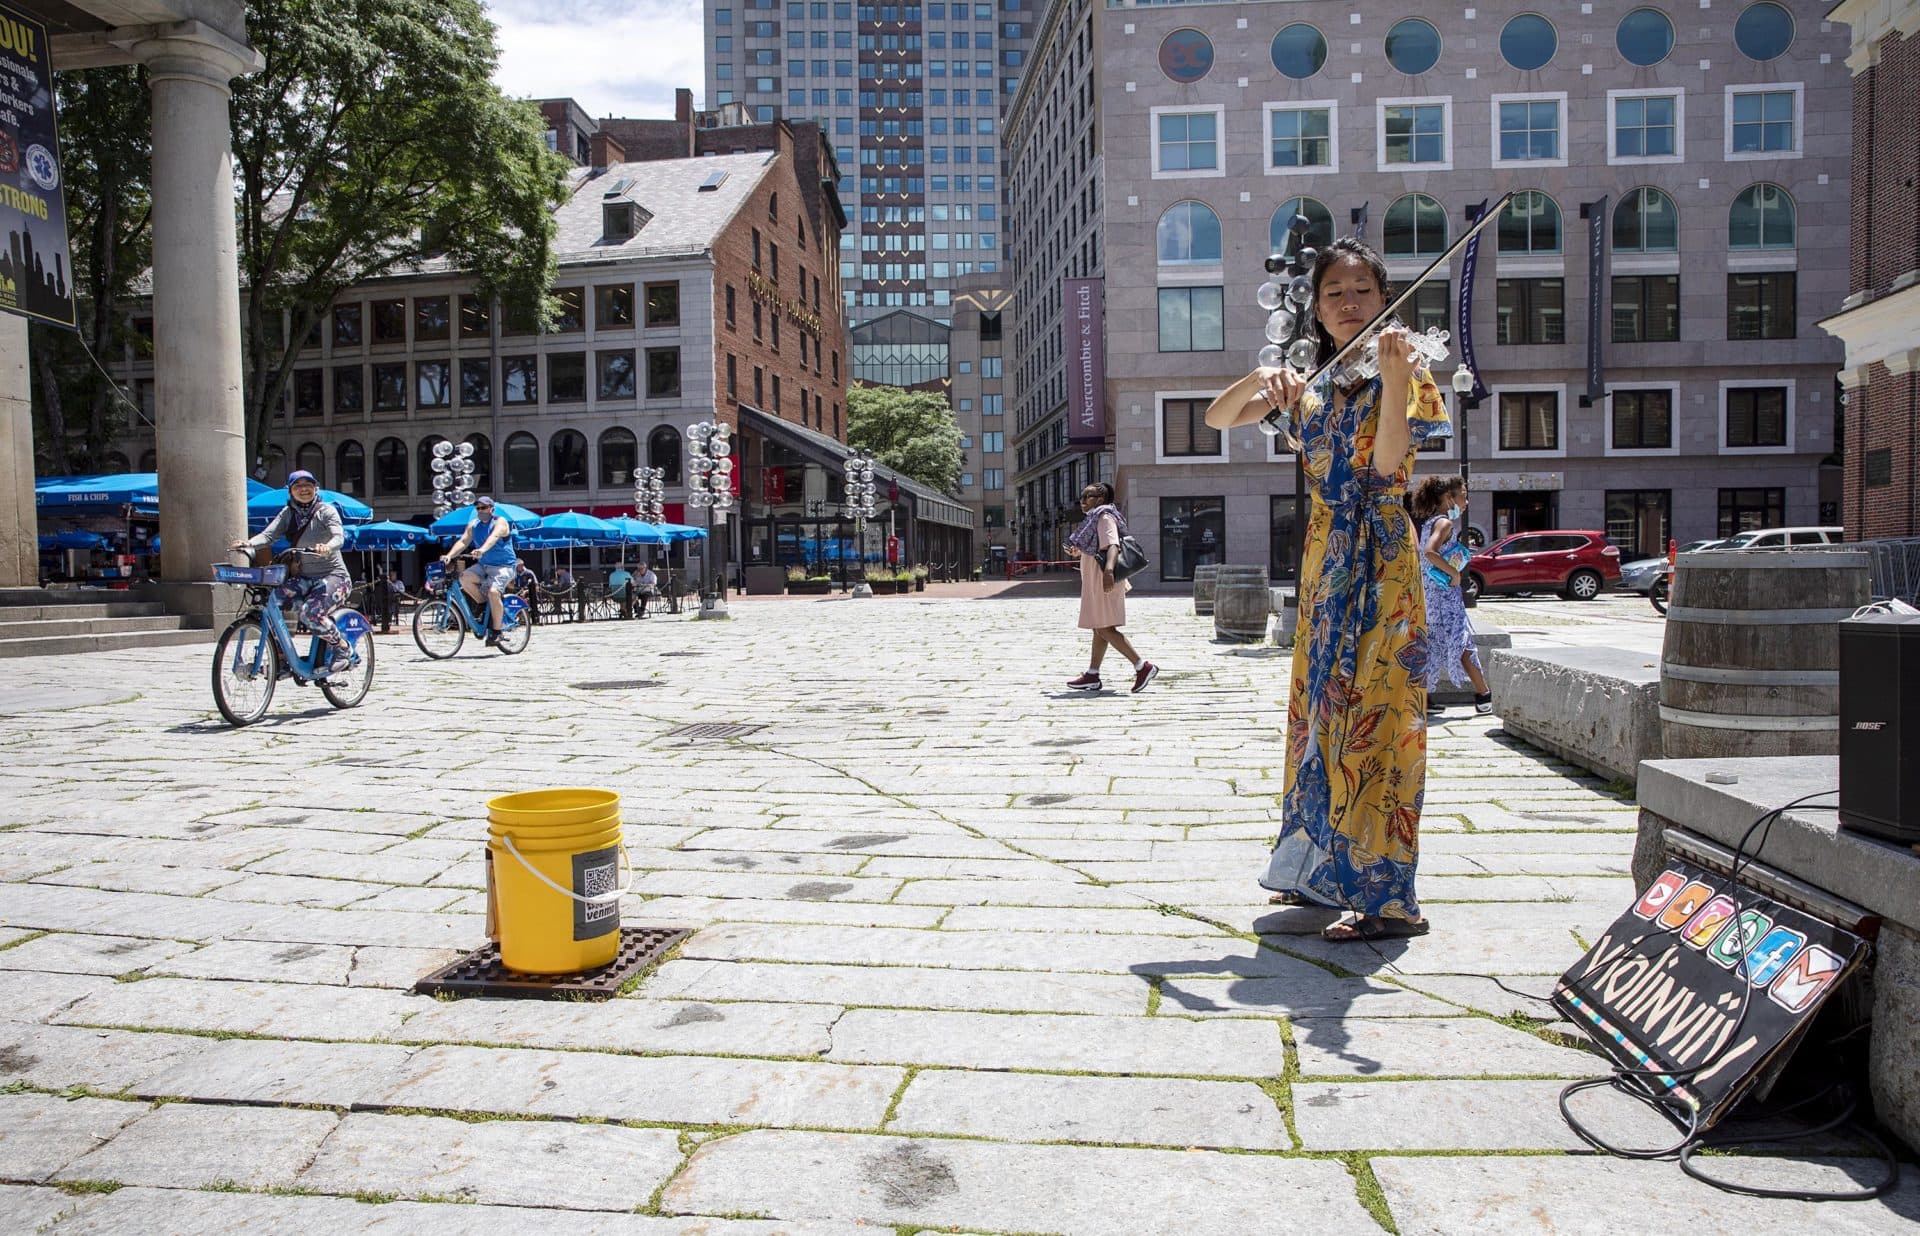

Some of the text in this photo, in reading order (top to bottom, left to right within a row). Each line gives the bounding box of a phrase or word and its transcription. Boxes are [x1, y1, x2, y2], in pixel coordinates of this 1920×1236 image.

[1077, 286, 1095, 428] Abercrombie & Fitch
[68, 492, 109, 502] FISH & CHIPS
[1851, 721, 1887, 730] BOSE
[586, 904, 615, 920] venmo
